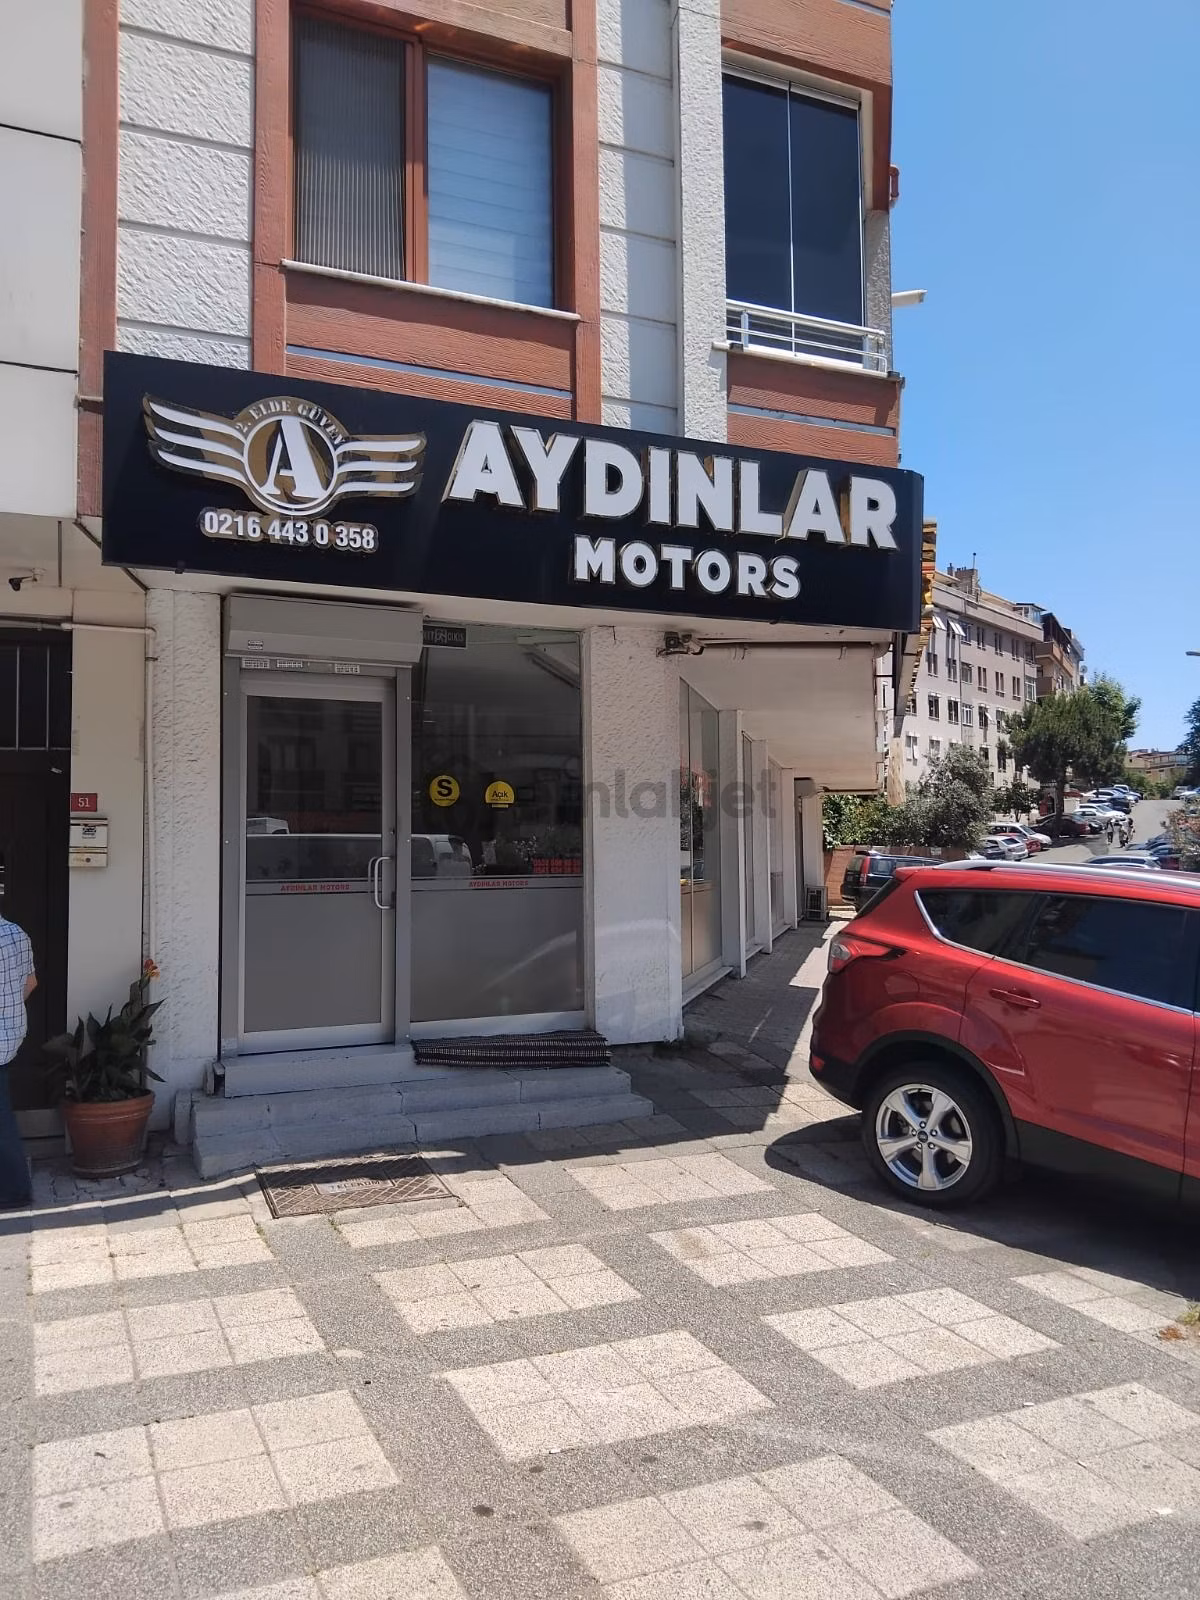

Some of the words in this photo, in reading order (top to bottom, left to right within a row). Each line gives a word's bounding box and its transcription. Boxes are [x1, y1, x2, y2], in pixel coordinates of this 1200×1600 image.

[235, 421, 252, 433] 2.
[249, 400, 292, 420] ELDE
[297, 403, 346, 445] GÜVEN
[260, 415, 328, 499] A
[443, 419, 898, 549] AYDINLAR
[204, 511, 261, 538] 0216
[267, 519, 309, 543] 443
[315, 523, 329, 545] 0
[335, 525, 375, 549] 358
[573, 536, 801, 599] MOTORS
[78, 797, 90, 808] 51
[437, 779, 453, 797] S
